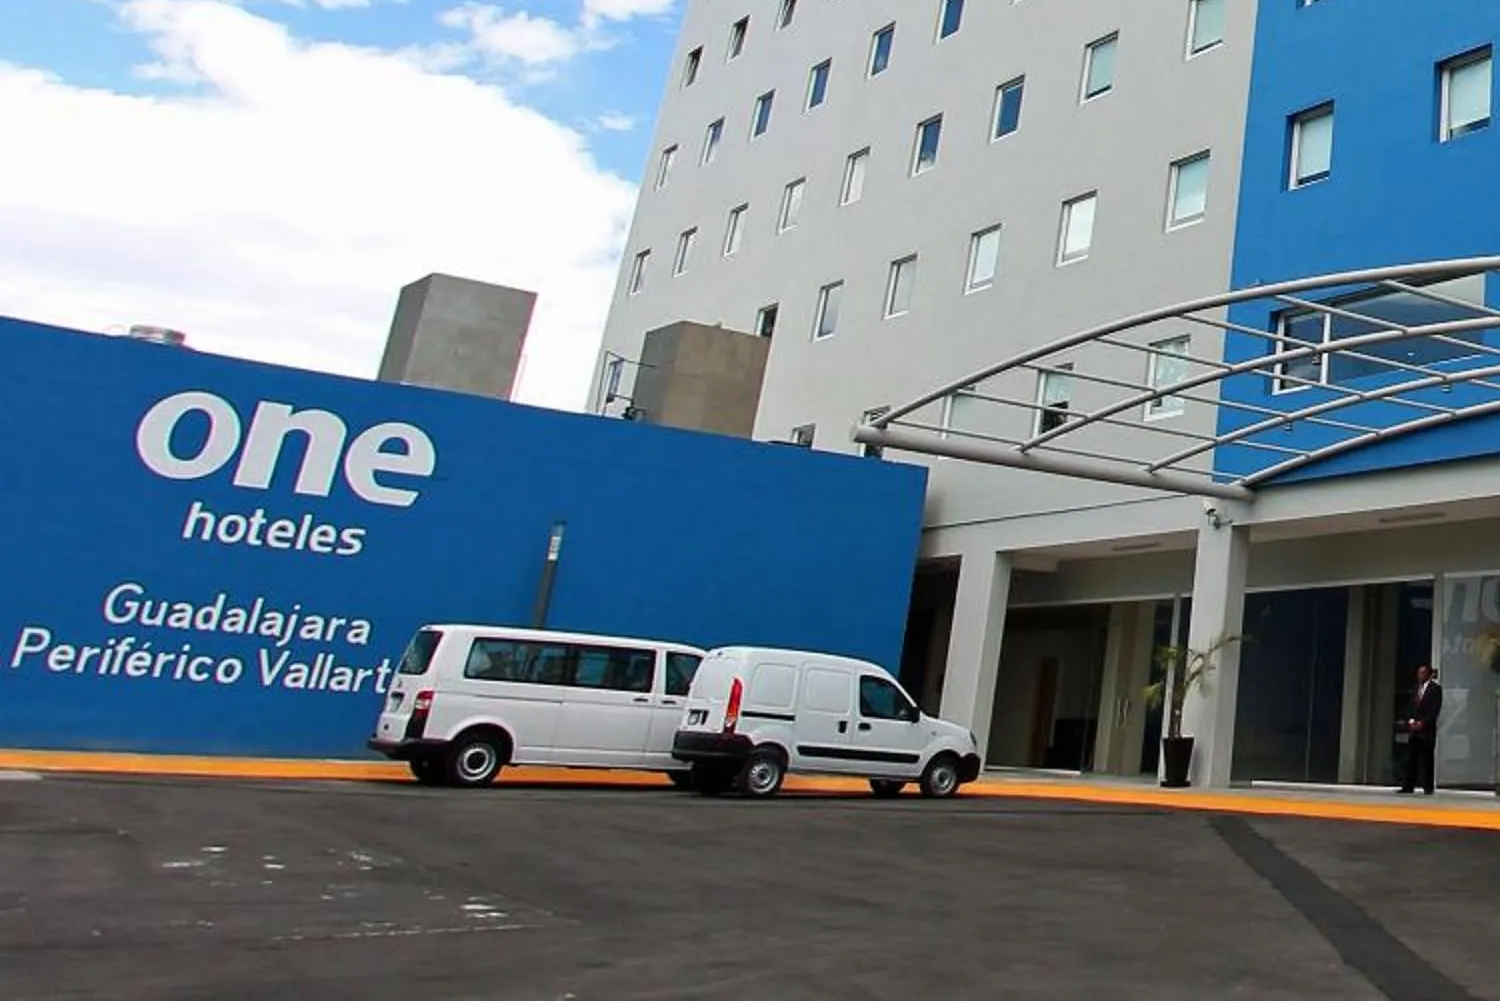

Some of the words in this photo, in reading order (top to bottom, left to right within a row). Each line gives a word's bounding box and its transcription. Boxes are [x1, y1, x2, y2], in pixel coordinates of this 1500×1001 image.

[136, 390, 436, 507] one
[182, 502, 366, 555] hoteles
[103, 582, 371, 646] Guadalajara
[11, 627, 242, 684] Periférico
[258, 649, 393, 695] Vallart
